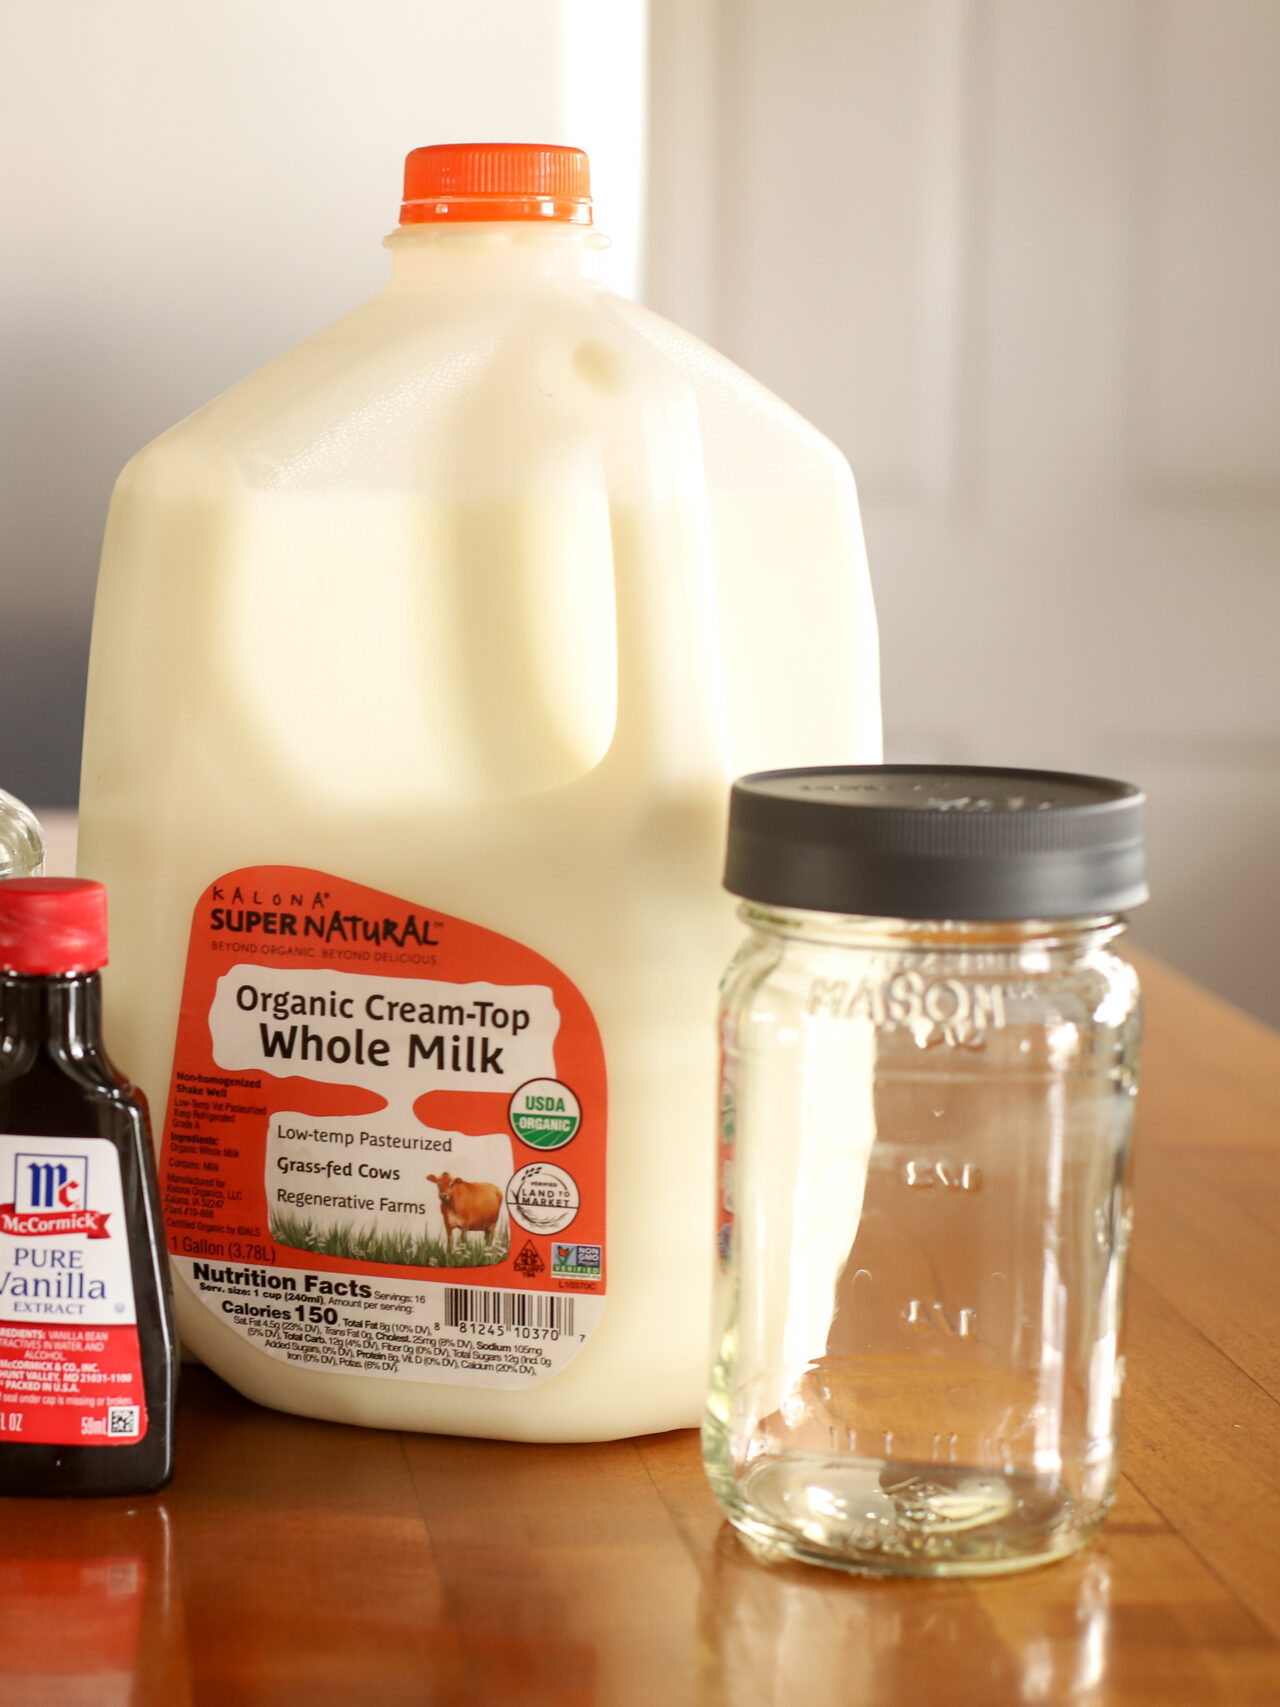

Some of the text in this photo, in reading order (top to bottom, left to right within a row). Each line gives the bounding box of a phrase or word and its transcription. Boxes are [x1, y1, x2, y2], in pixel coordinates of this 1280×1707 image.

[212, 886, 325, 909] KALONA
[211, 940, 257, 954] BEYOND
[322, 949, 370, 961] BEYOND
[236, 985, 530, 1036] Organic Cream-Top
[259, 1022, 504, 1074] Whole Milk
[525, 1095, 565, 1112] USDA
[519, 1116, 571, 1132] ORGANIC
[277, 1125, 452, 1152] Low-temp Pasteurized
[277, 1157, 400, 1180] Grass-fed Cows
[277, 1188, 426, 1214] Regenerative Farms
[522, 1188, 555, 1198] LAND
[521, 1197, 570, 1208] MARKET
[1, 1213, 99, 1232] McCormick
[13, 1248, 84, 1269] PURE
[171, 1236, 276, 1264] 1 Gallon (3.78L)
[554, 1266, 599, 1275] VERIFIED
[193, 1262, 372, 1299] Nutrition Facts
[200, 1282, 225, 1293] Serv.
[228, 1286, 251, 1296] size:
[263, 1291, 282, 1300] cup
[328, 1297, 361, 1308] Amount
[363, 1301, 378, 1310] per
[380, 1303, 415, 1315] serving:
[374, 1291, 426, 1304] Servings: 16
[13, 1301, 86, 1315] EXTRACT
[221, 1300, 291, 1320] Calories
[342, 1318, 363, 1328] Total
[365, 1320, 378, 1330] Fat
[433, 1322, 440, 1331] 8
[459, 1322, 559, 1341] 81245 10370
[48, 1330, 84, 1340] VANILLA
[85, 1331, 108, 1342] BEAN
[324, 1326, 345, 1336] Trans
[347, 1328, 360, 1338] Fat
[476, 1341, 512, 1352] Sodium
[514, 1345, 542, 1357] 105mg
[579, 1335, 586, 1343] 7
[43, 1341, 52, 1350] IN
[84, 1342, 104, 1352] AND
[264, 1339, 290, 1350] Added
[356, 1350, 386, 1360] Protein
[415, 1355, 422, 1364] D
[283, 1331, 303, 1341] Total
[329, 1337, 344, 1348] 12g
[453, 1350, 471, 1359] Total
[471, 1351, 502, 1363] Sugars
[504, 1354, 519, 1365] 12g
[287, 1352, 302, 1361] Iron
[54, 1361, 62, 1371] &
[0, 1370, 25, 1380] HUNT
[63, 1373, 79, 1382] MD
[5, 1381, 80, 1392] PACKED IN U.S.A.
[9, 1413, 23, 1431] OZ
